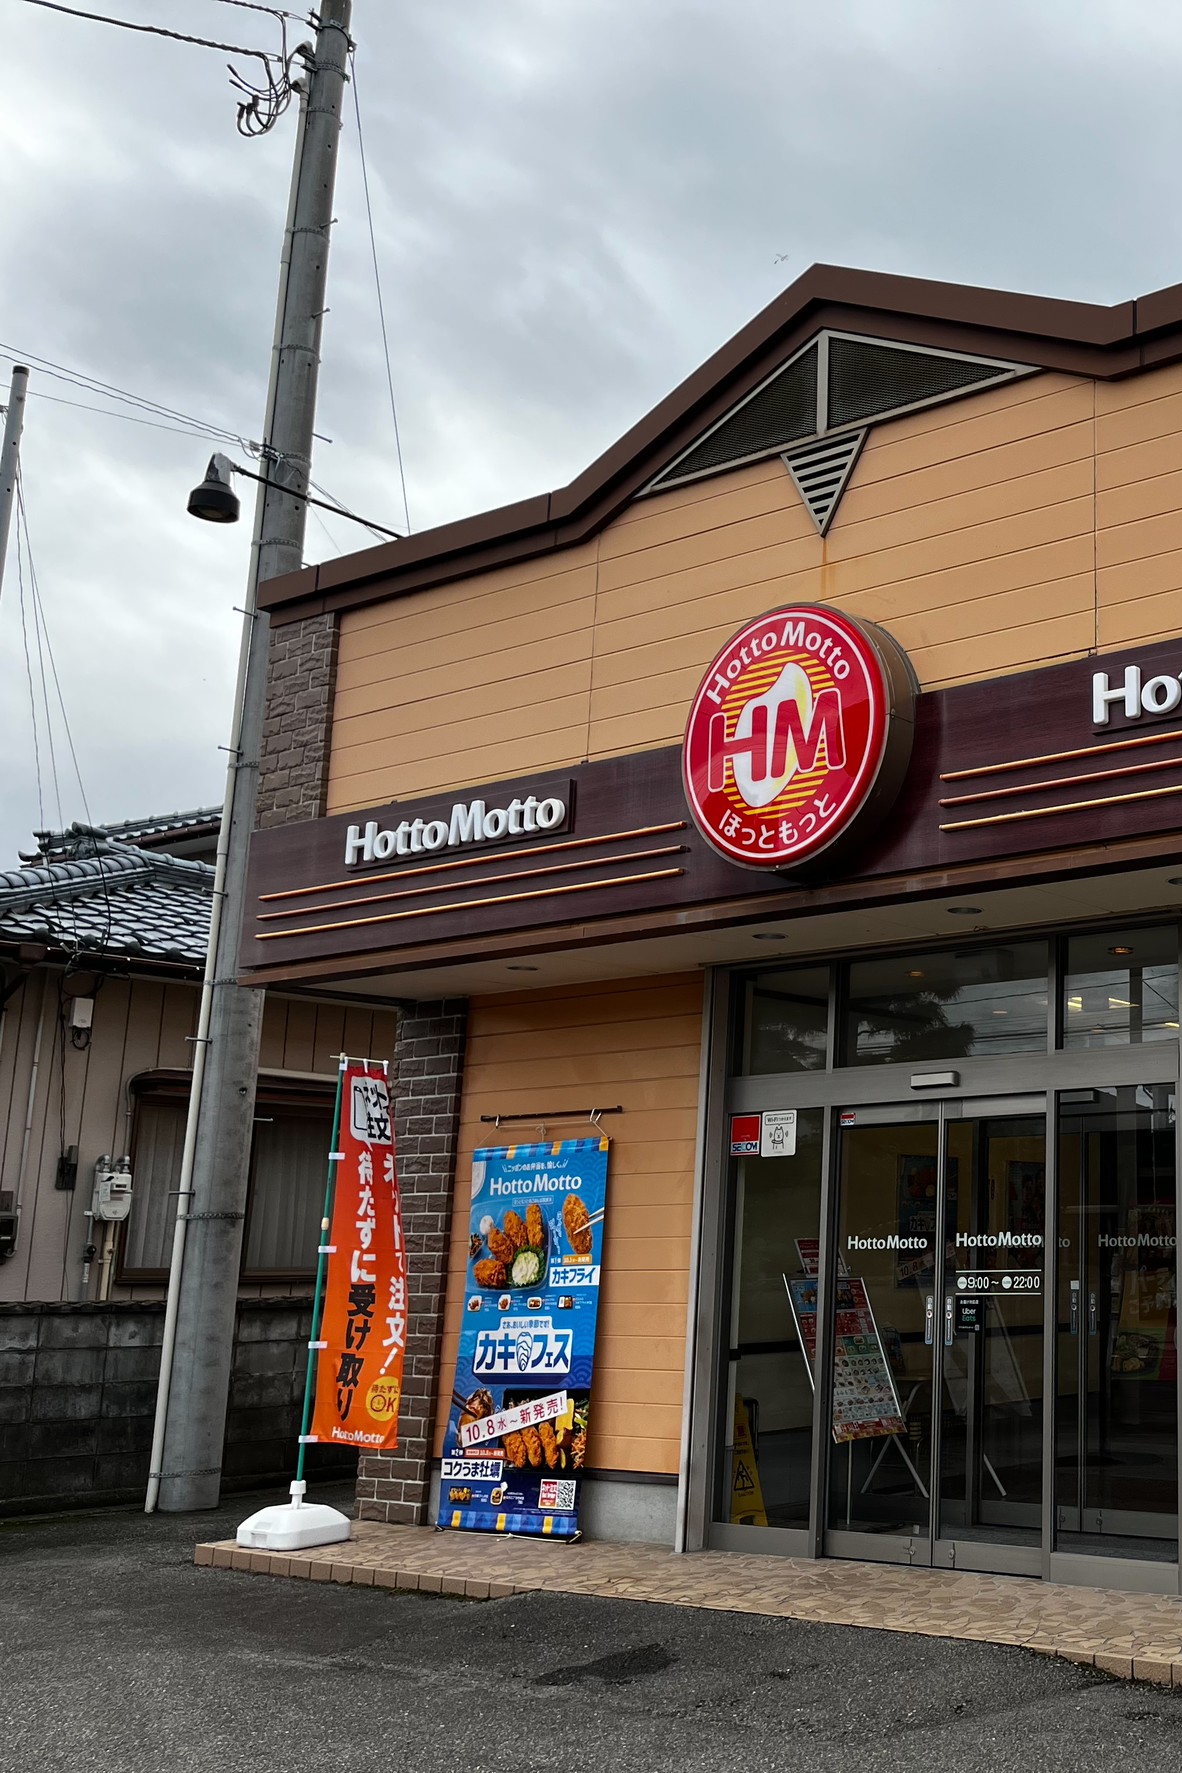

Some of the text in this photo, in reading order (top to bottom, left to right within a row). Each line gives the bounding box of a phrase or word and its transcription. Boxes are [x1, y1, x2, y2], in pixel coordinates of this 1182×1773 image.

[707, 622, 851, 704] HottoMotto
[719, 792, 836, 851] ほっともっと
[345, 796, 566, 866] HottoMotto
[732, 1142, 758, 1152] SECOM
[847, 1235, 928, 1250] HottoMotto
[955, 1231, 1042, 1248] HottoMotto
[552, 1267, 596, 1285] カキフライ
[968, 1276, 990, 1289] 9:00
[1013, 1276, 1040, 1289] 22:00
[336, 1151, 376, 1421] 待たずに受け取り
[961, 1307, 977, 1315] Uber
[475, 1333, 570, 1371] カキ フェス
[444, 1460, 501, 1479] コクうま牡蠣
